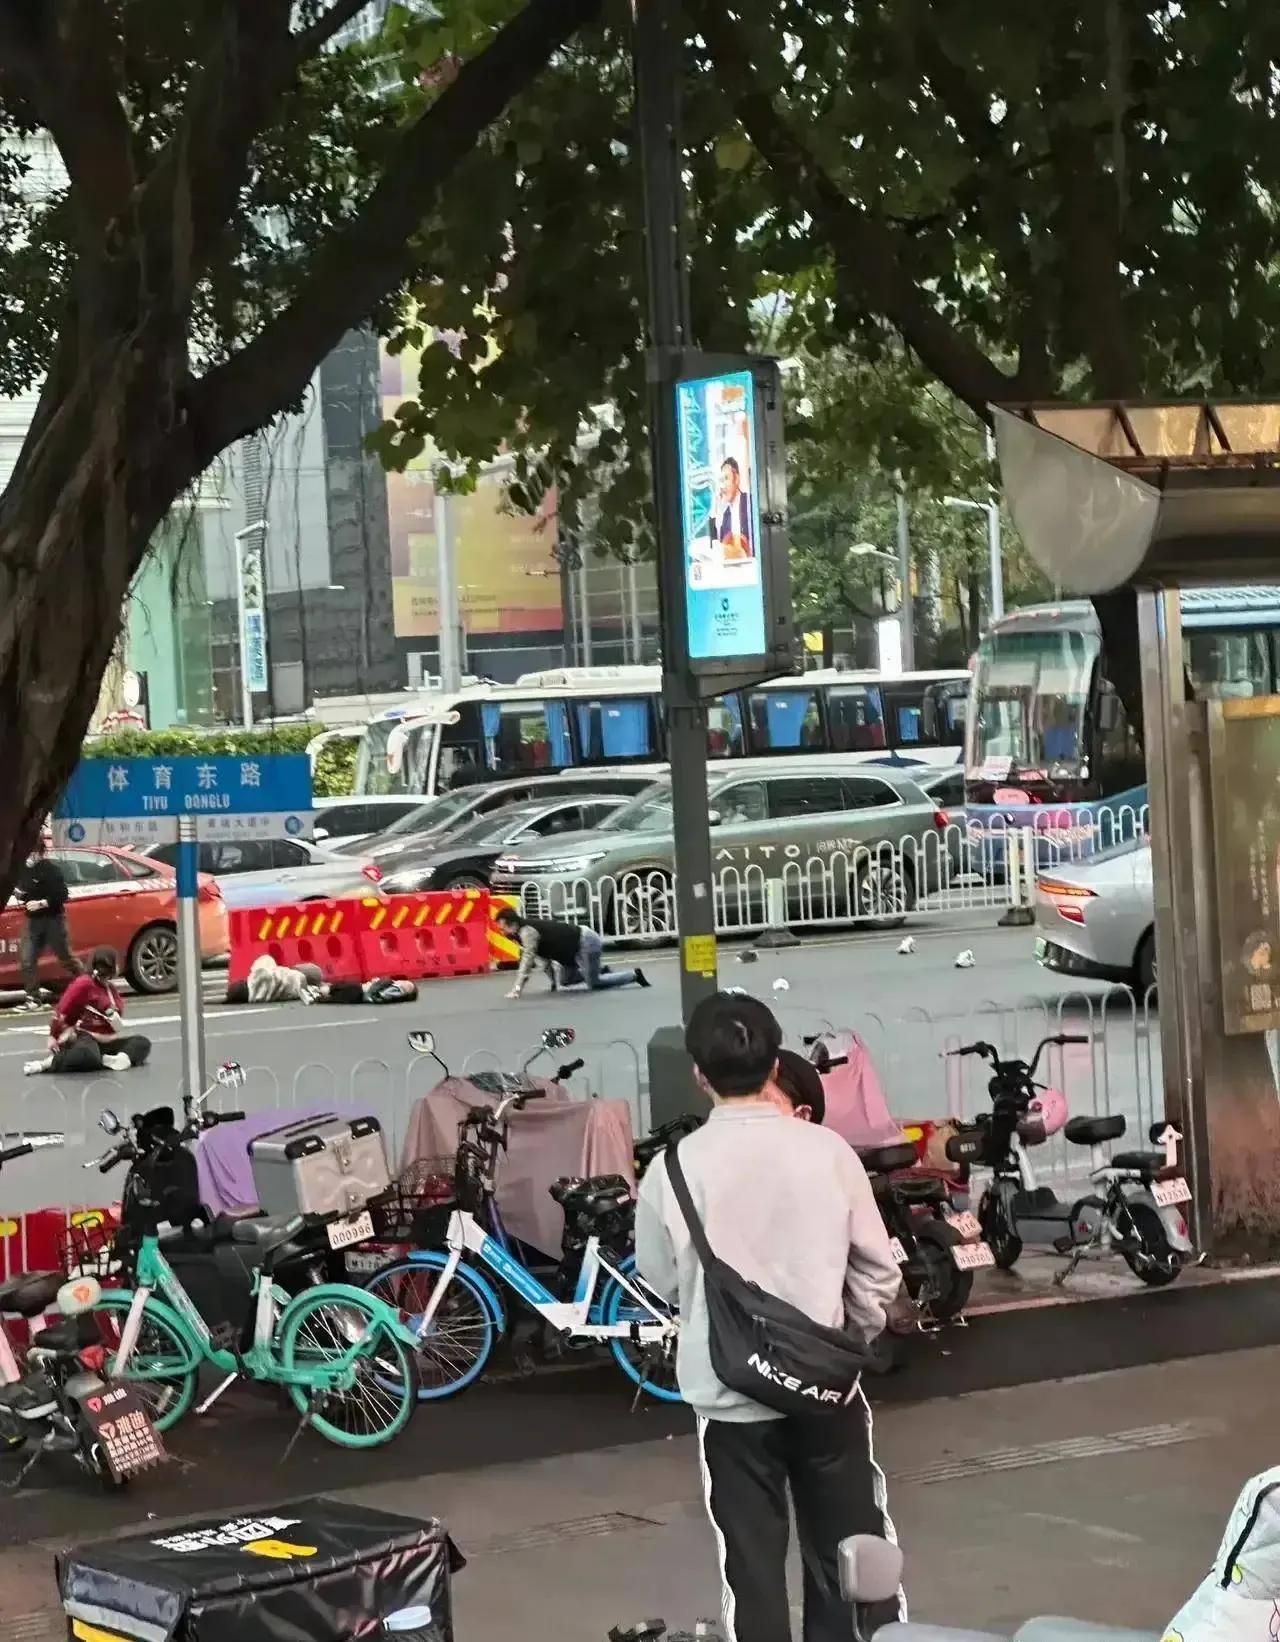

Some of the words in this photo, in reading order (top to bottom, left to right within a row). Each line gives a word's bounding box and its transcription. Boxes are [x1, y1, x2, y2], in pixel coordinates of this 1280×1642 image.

[107, 761, 262, 792] 体育东路
[142, 795, 168, 810] TIYU
[185, 794, 230, 809] DONGLU
[715, 844, 801, 861] AITO
[332, 1224, 371, 1246] 000996
[747, 1352, 802, 1392] NIKE
[801, 1385, 843, 1404] AIR
